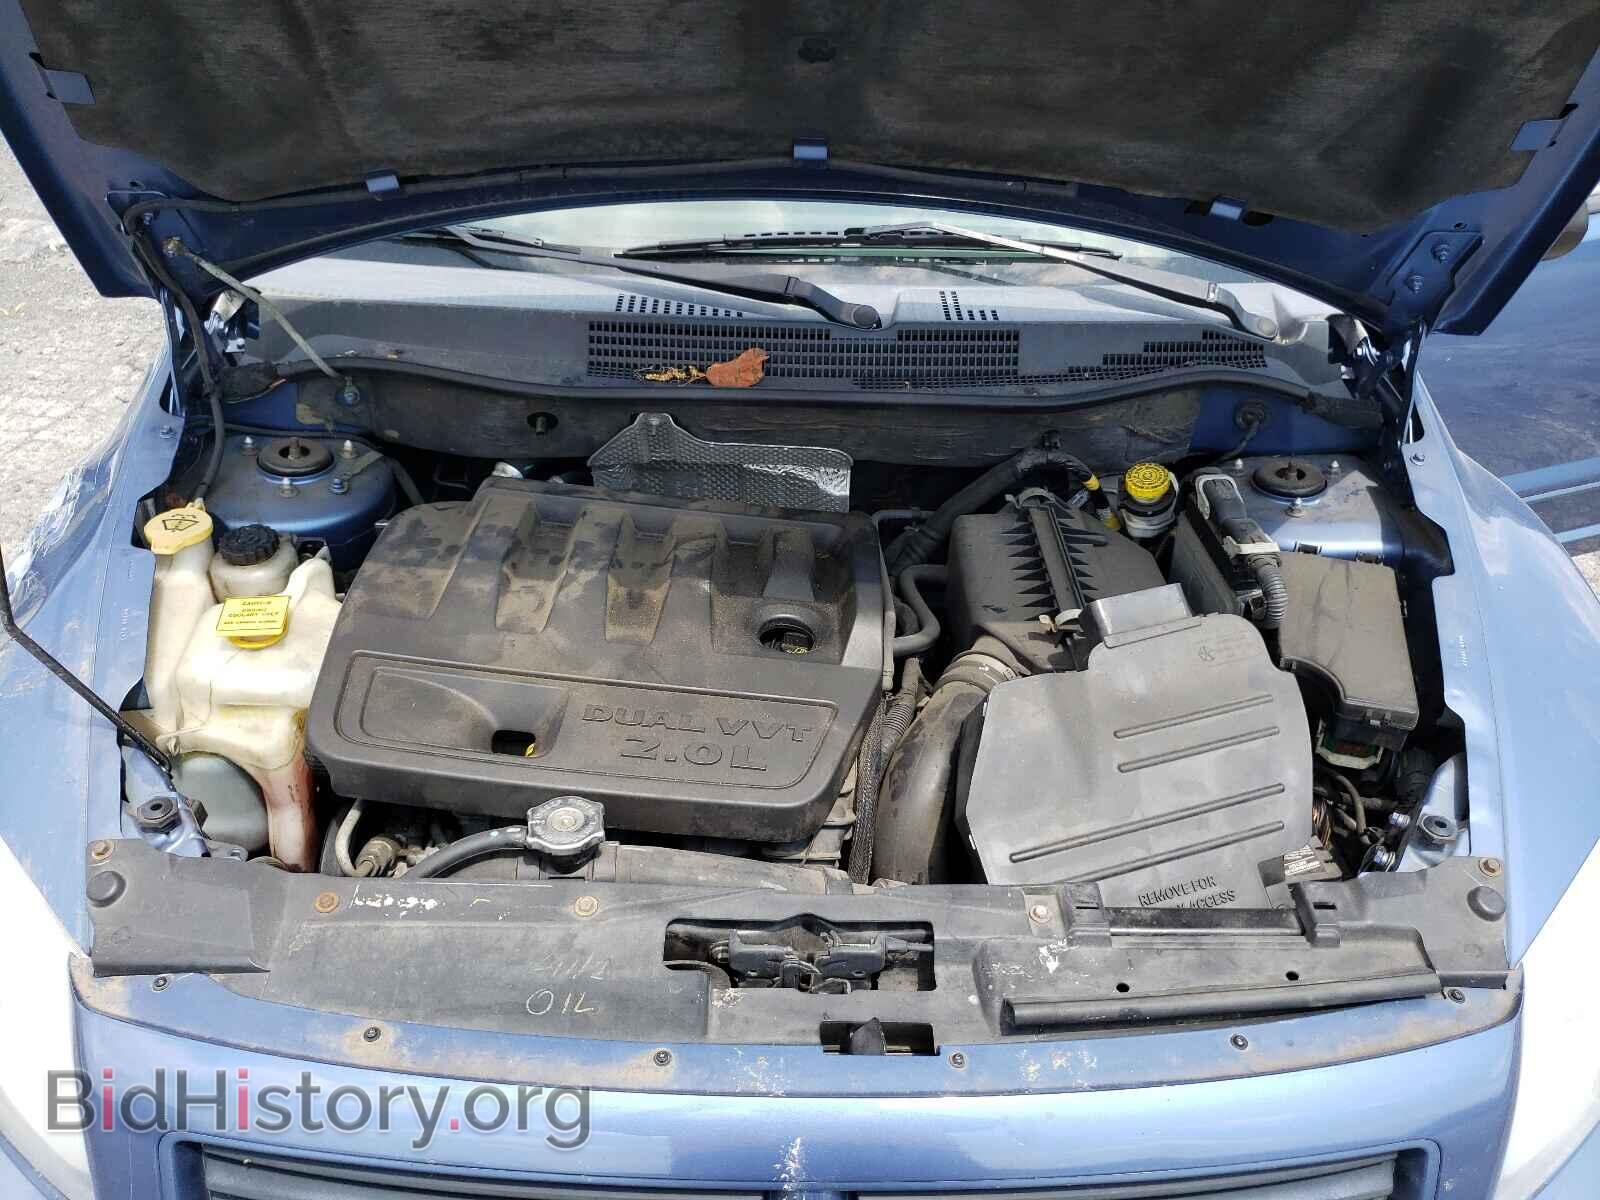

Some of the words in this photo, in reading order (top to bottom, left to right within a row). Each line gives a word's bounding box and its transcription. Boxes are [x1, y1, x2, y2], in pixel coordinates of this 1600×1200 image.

[582, 704, 706, 733] DUAL
[716, 716, 813, 742] VVT
[620, 738, 767, 772] 2.0L
[1137, 881, 1190, 907] REMOVE
[1190, 876, 1217, 893] FOR
[1189, 889, 1236, 909] ACCESS
[526, 988, 594, 1015] OIL
